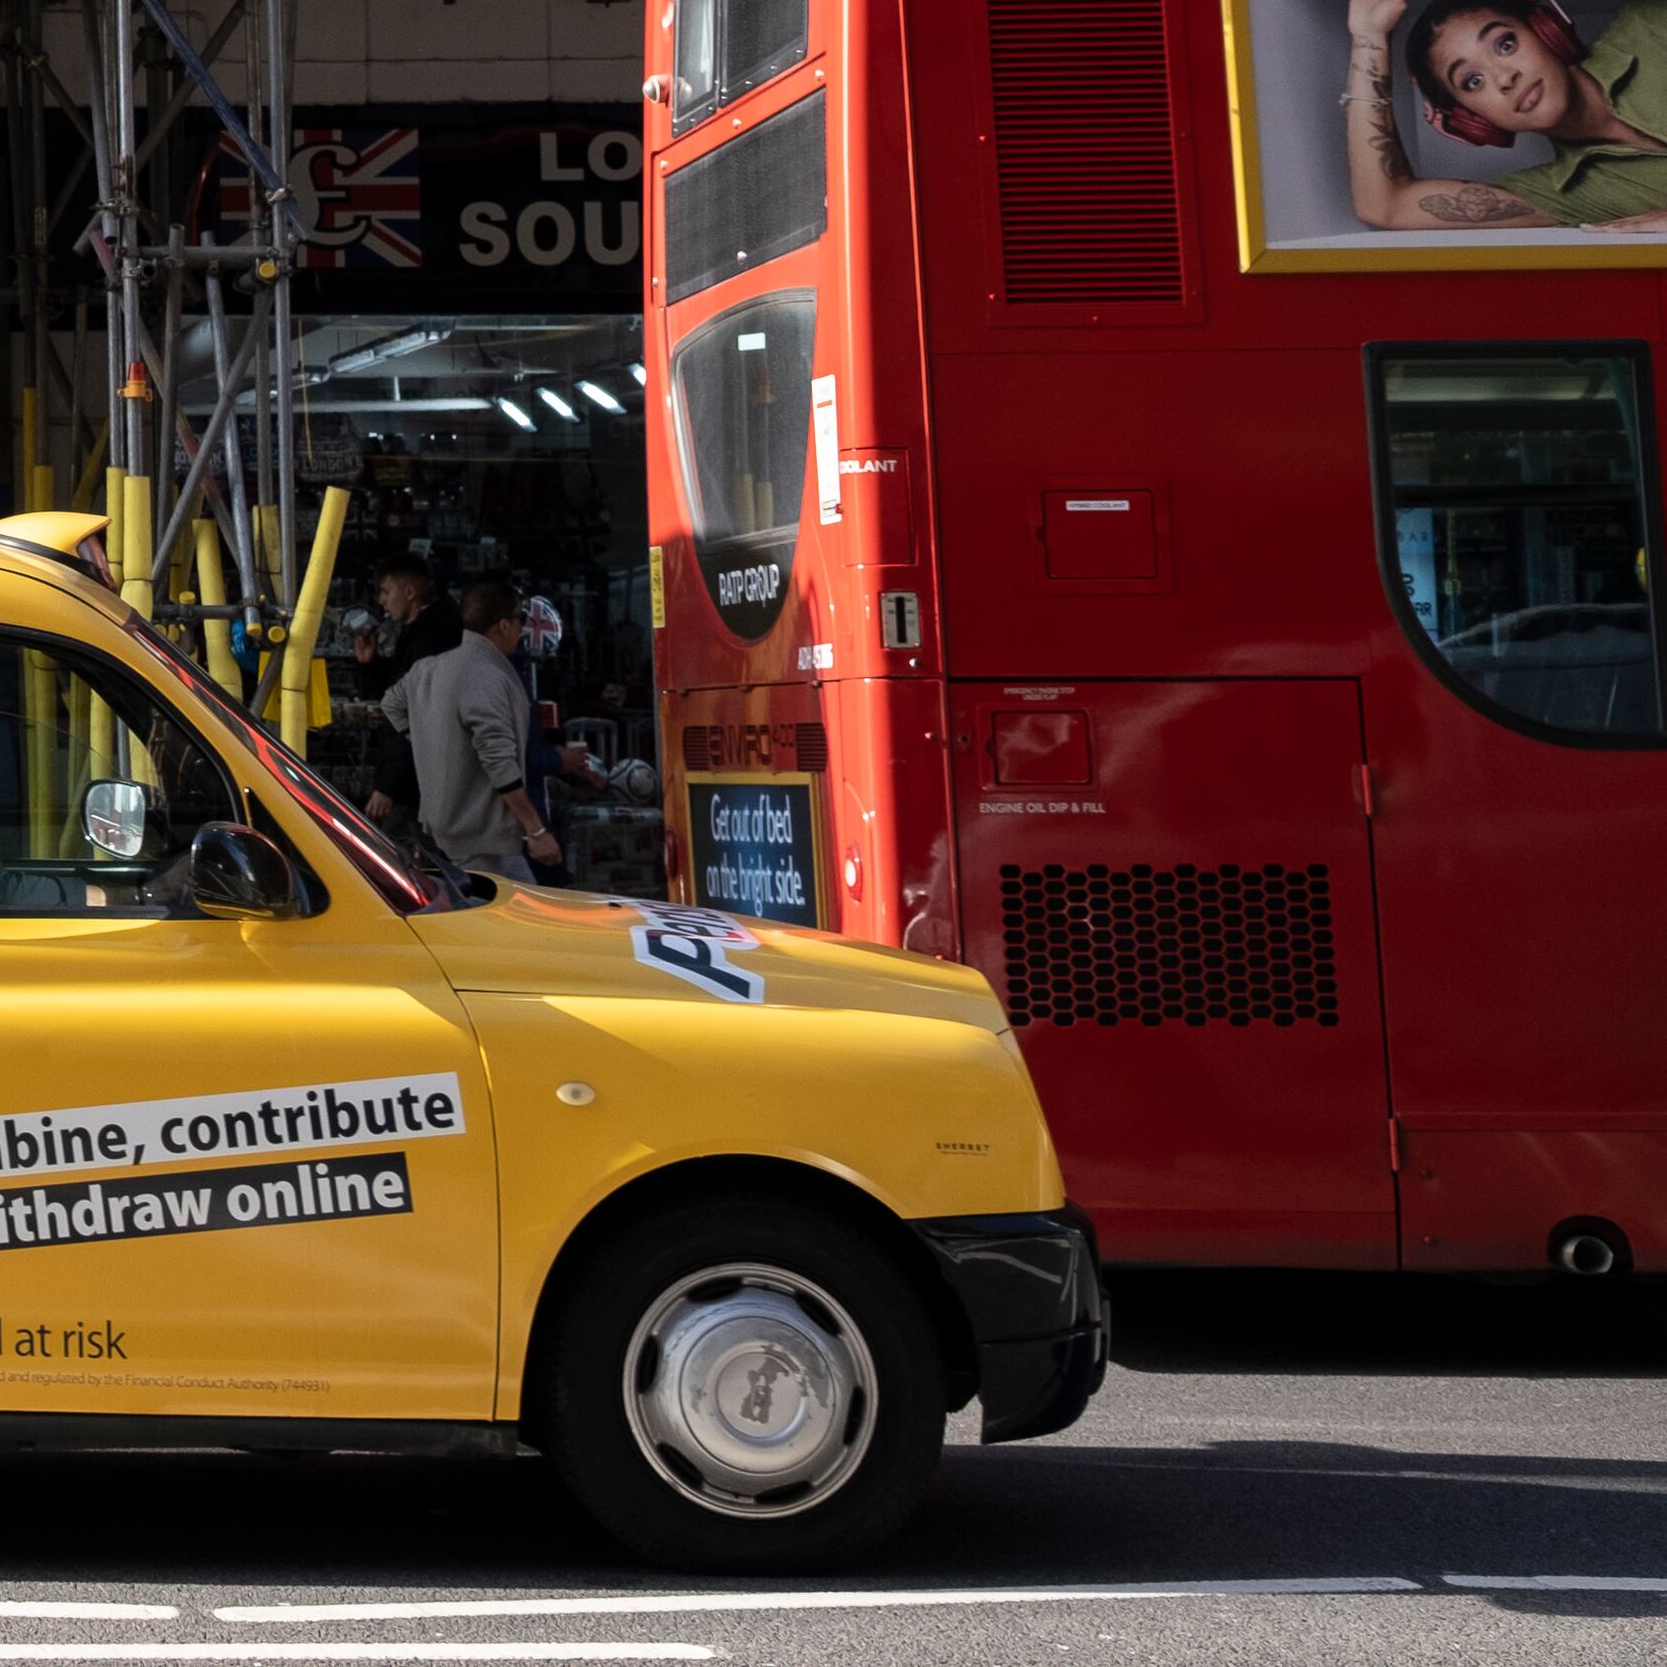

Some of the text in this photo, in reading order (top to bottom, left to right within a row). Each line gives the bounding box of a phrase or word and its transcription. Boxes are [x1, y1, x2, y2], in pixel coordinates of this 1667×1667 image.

[539, 130, 643, 182] LO
[459, 200, 641, 266] SOU
[718, 563, 780, 607] RATP GROUP
[710, 793, 793, 844] Get out of bed
[979, 802, 1106, 813] ENGINE OIL DIP & FILL
[707, 852, 805, 918] on the bright side.
[161, 1087, 455, 1155] contribute
[935, 1142, 990, 1152] SHERBET
[227, 1162, 405, 1223] online
[15, 1324, 52, 1357] at
[64, 1320, 128, 1359] risk
[8, 1370, 30, 1383] and
[31, 1371, 85, 1386] regulated
[88, 1372, 102, 1388] by
[104, 1374, 123, 1385] the
[125, 1374, 174, 1387] Financial
[176, 1375, 224, 1389] Conduct
[227, 1377, 279, 1392] Authority
